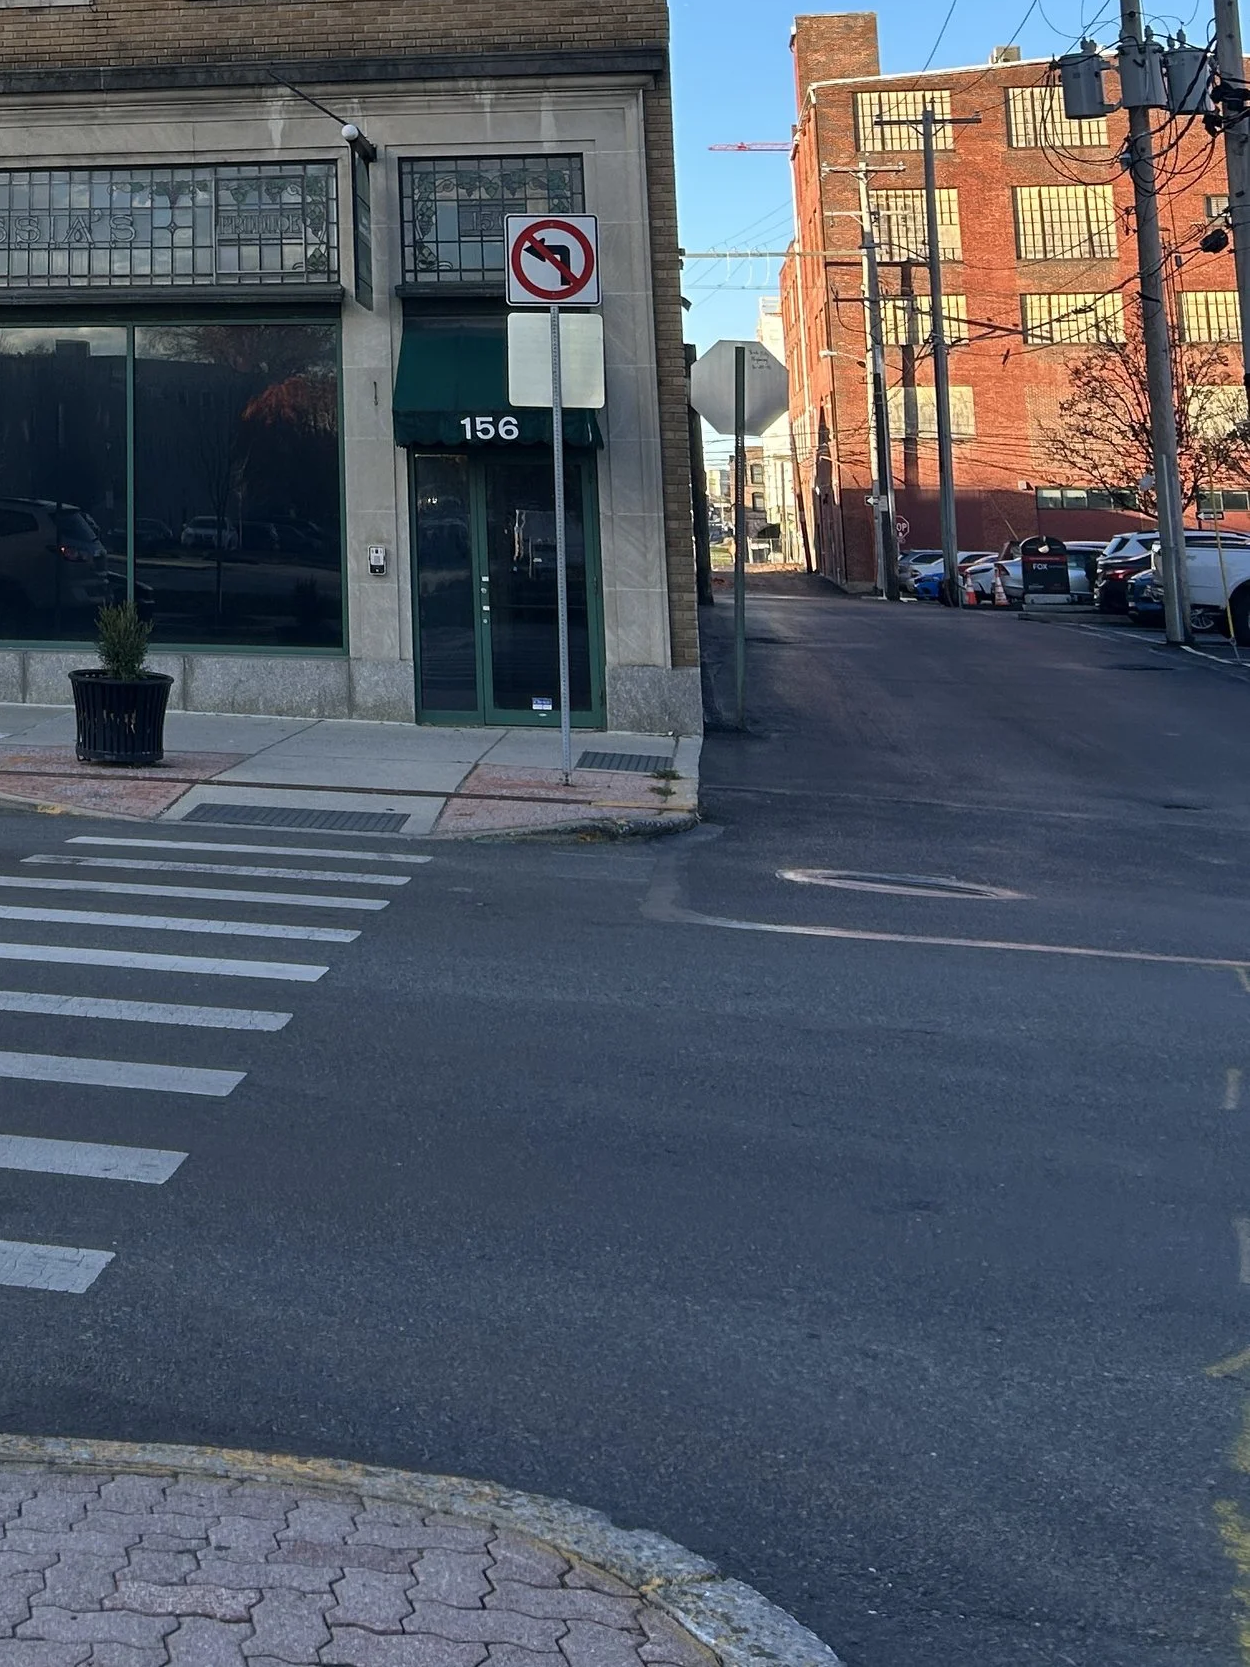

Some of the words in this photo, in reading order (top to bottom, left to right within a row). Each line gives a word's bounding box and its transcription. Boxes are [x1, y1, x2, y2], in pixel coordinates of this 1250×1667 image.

[460, 416, 519, 440] 156
[896, 522, 908, 532] OP
[1032, 563, 1048, 571] FOX
